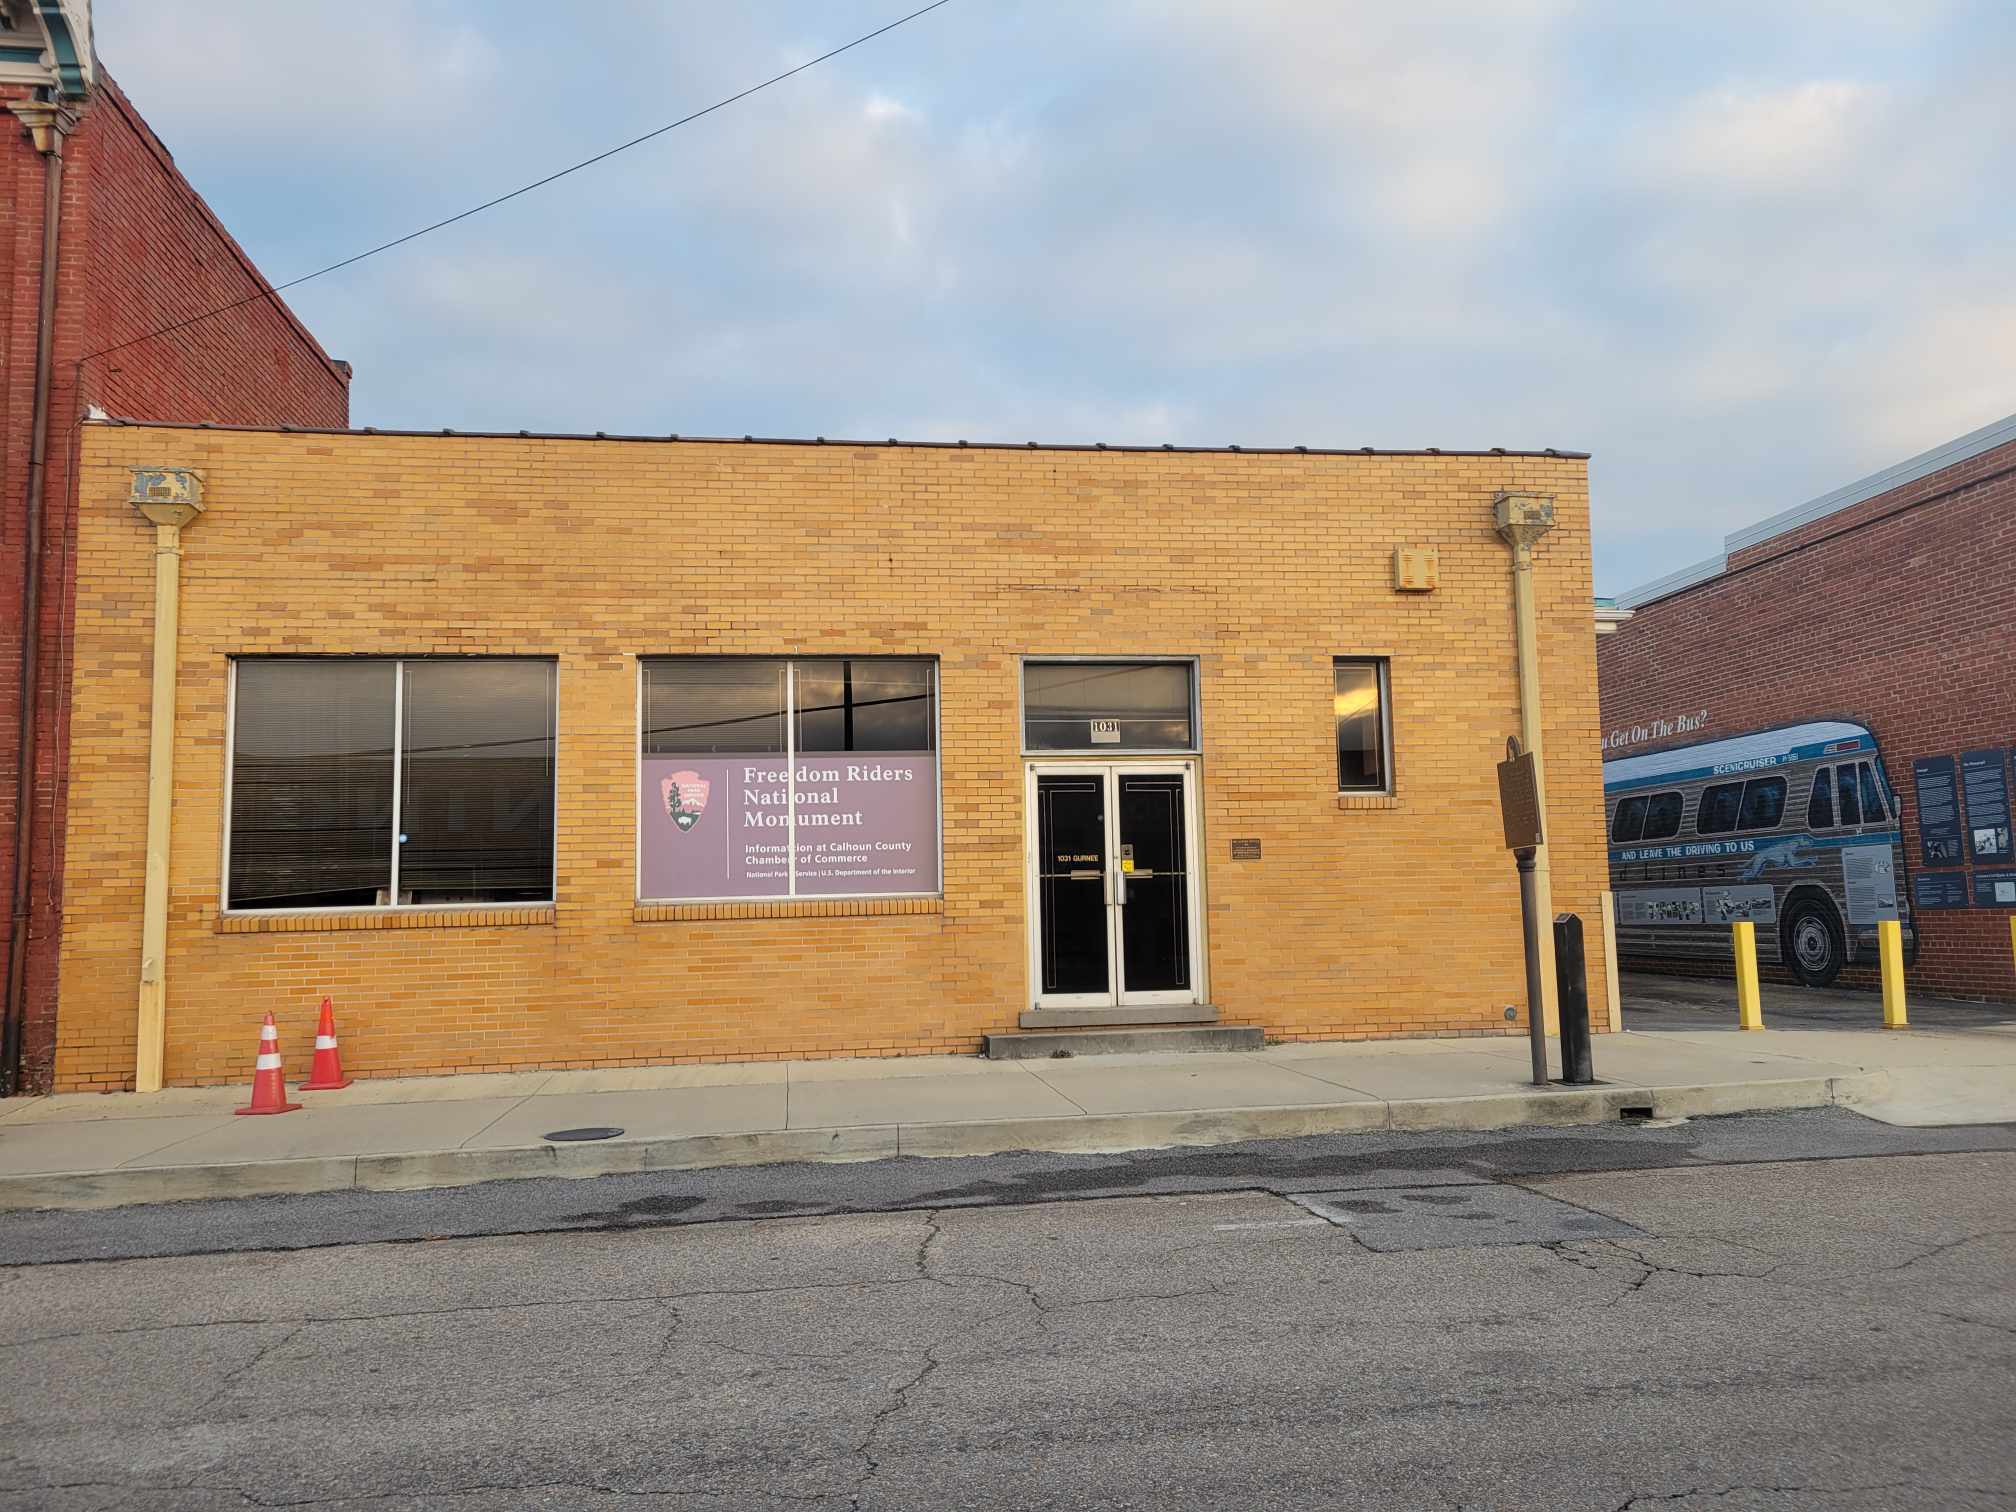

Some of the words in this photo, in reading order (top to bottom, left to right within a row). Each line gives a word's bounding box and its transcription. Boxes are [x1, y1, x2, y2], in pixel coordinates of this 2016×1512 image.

[1094, 720, 1118, 732] 1031
[1610, 730, 1629, 748] Get
[1631, 725, 1648, 743] On
[1651, 720, 1674, 739] The
[1677, 710, 1708, 733] Bus?
[743, 766, 840, 783] Freedom
[845, 765, 914, 782] Riders
[1713, 756, 1777, 775] SCENICRUISER
[743, 787, 840, 805] National
[743, 810, 864, 827] Monument
[745, 842, 813, 854] Informaion
[816, 843, 827, 852] at
[830, 842, 872, 852] Calhoun
[875, 841, 912, 852] County
[1621, 850, 1637, 861] AND
[1639, 848, 1663, 859] LEAVE
[1666, 846, 1682, 857] THE
[1685, 843, 1721, 856] DRIVING
[1724, 842, 1738, 853] TO
[1740, 840, 1754, 852] US
[800, 854, 812, 863] of
[815, 854, 868, 864] Commerce
